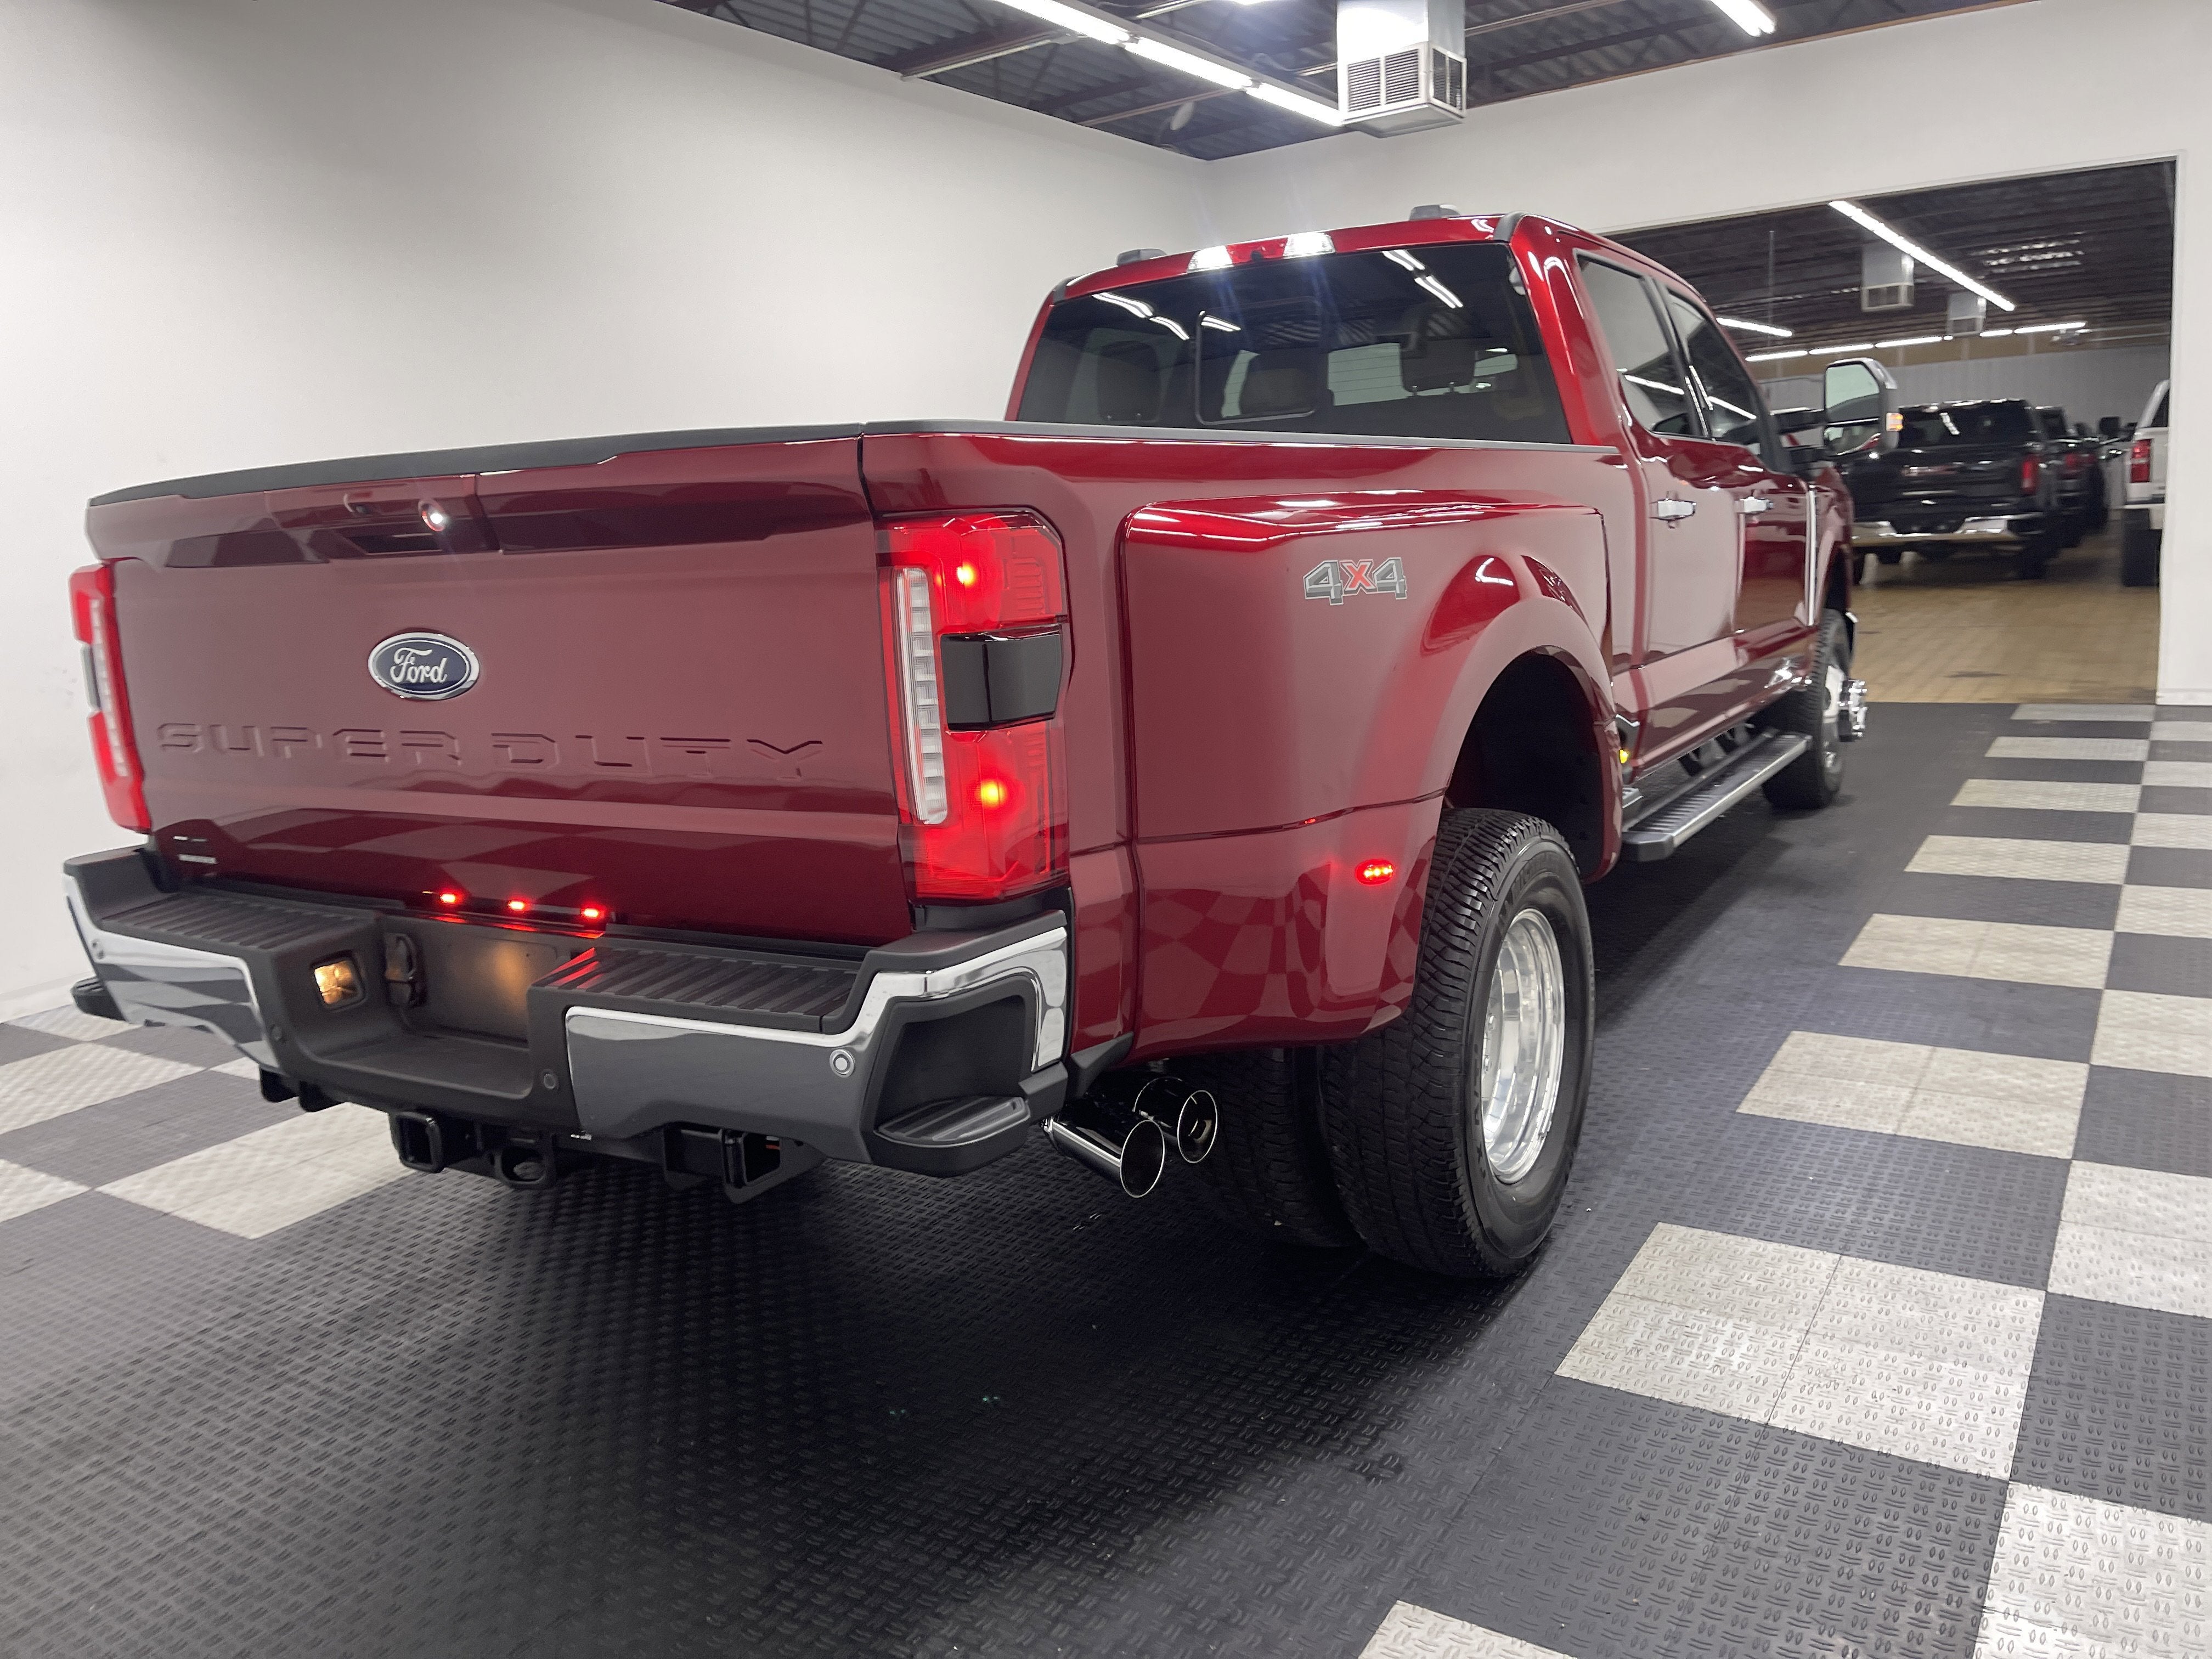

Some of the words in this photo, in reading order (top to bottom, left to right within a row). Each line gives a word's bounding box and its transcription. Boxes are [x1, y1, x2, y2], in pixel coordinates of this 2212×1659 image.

[1302, 557, 1408, 606] 4X4
[390, 647, 448, 684] Ford
[157, 723, 462, 766] SUPER
[491, 732, 823, 780] DUTY
